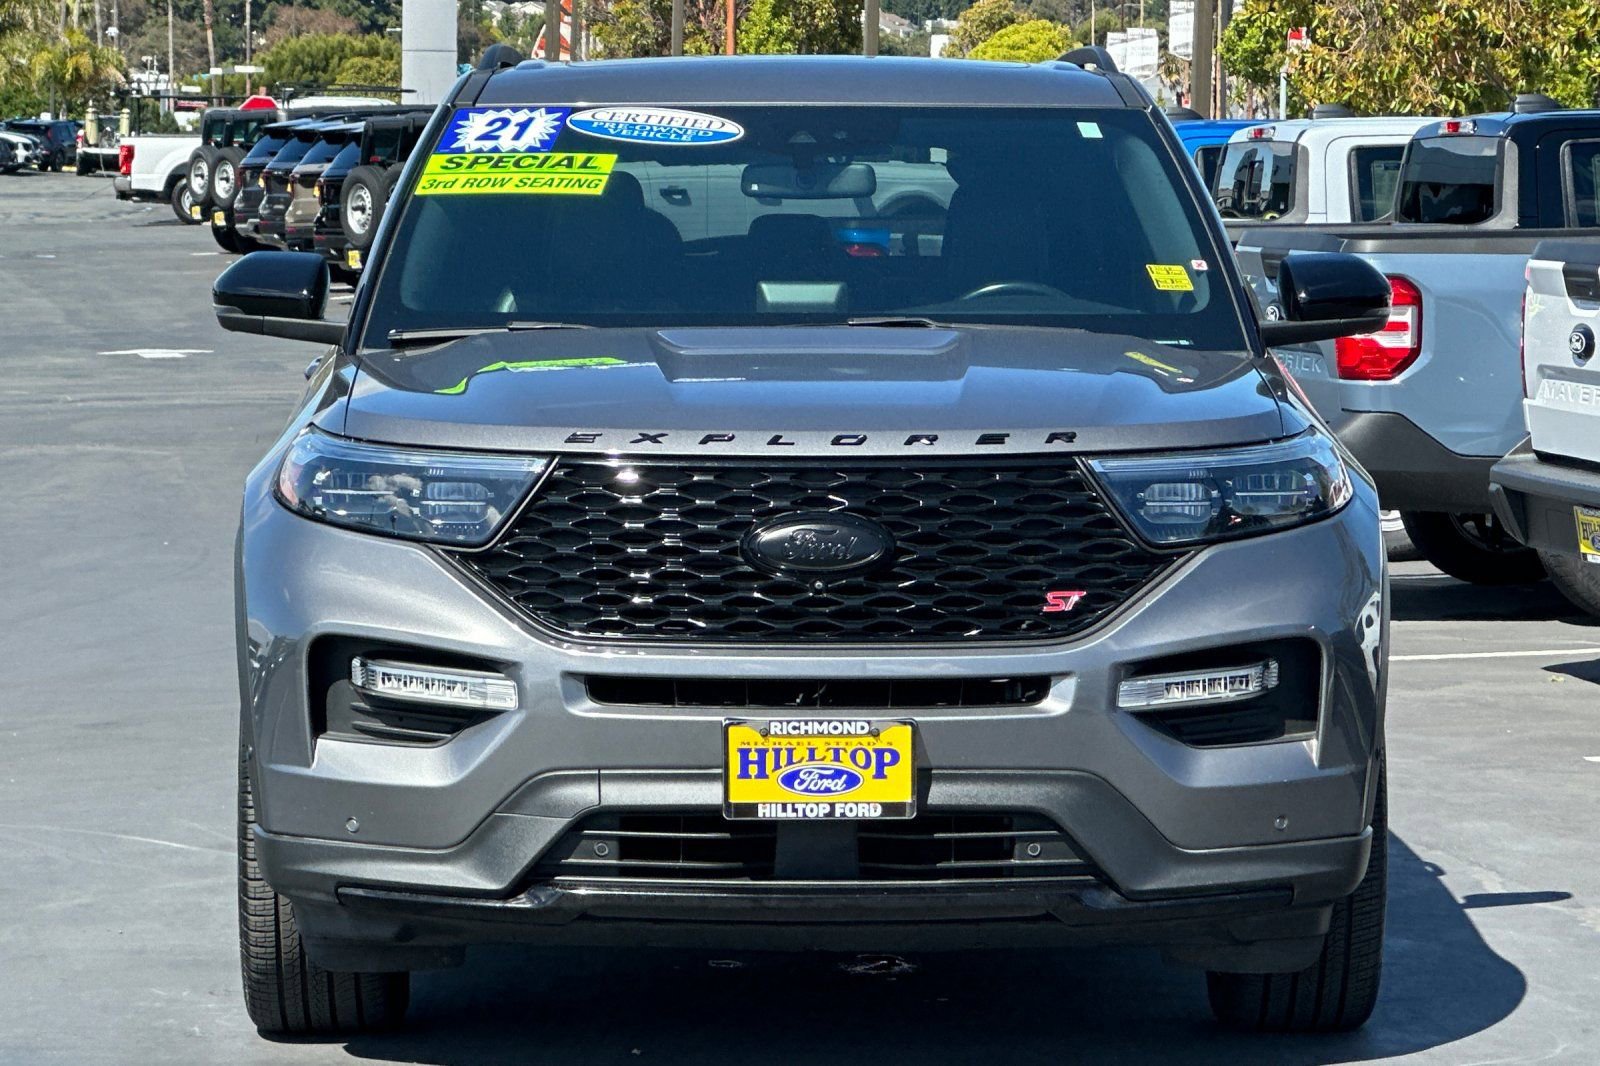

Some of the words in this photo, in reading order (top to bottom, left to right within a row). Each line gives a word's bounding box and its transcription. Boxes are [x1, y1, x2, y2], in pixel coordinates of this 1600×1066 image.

[474, 116, 536, 141] 21
[591, 111, 726, 130] CERTIFIED
[591, 121, 714, 138] PRE-OWNED
[607, 128, 694, 142] VEHICLE
[439, 155, 601, 171] SPECIAL
[421, 177, 458, 190] 3rd
[460, 177, 511, 189] ROW
[514, 177, 603, 189] SEATING
[563, 431, 1078, 446] EXPLORER
[783, 528, 858, 560] Ford
[1042, 590, 1087, 612] ST
[769, 720, 870, 736] RICHMOND
[737, 746, 901, 780] HILLTOP
[793, 768, 848, 792] Ford
[757, 802, 831, 818] HILLTOP
[834, 802, 882, 818] FORD
